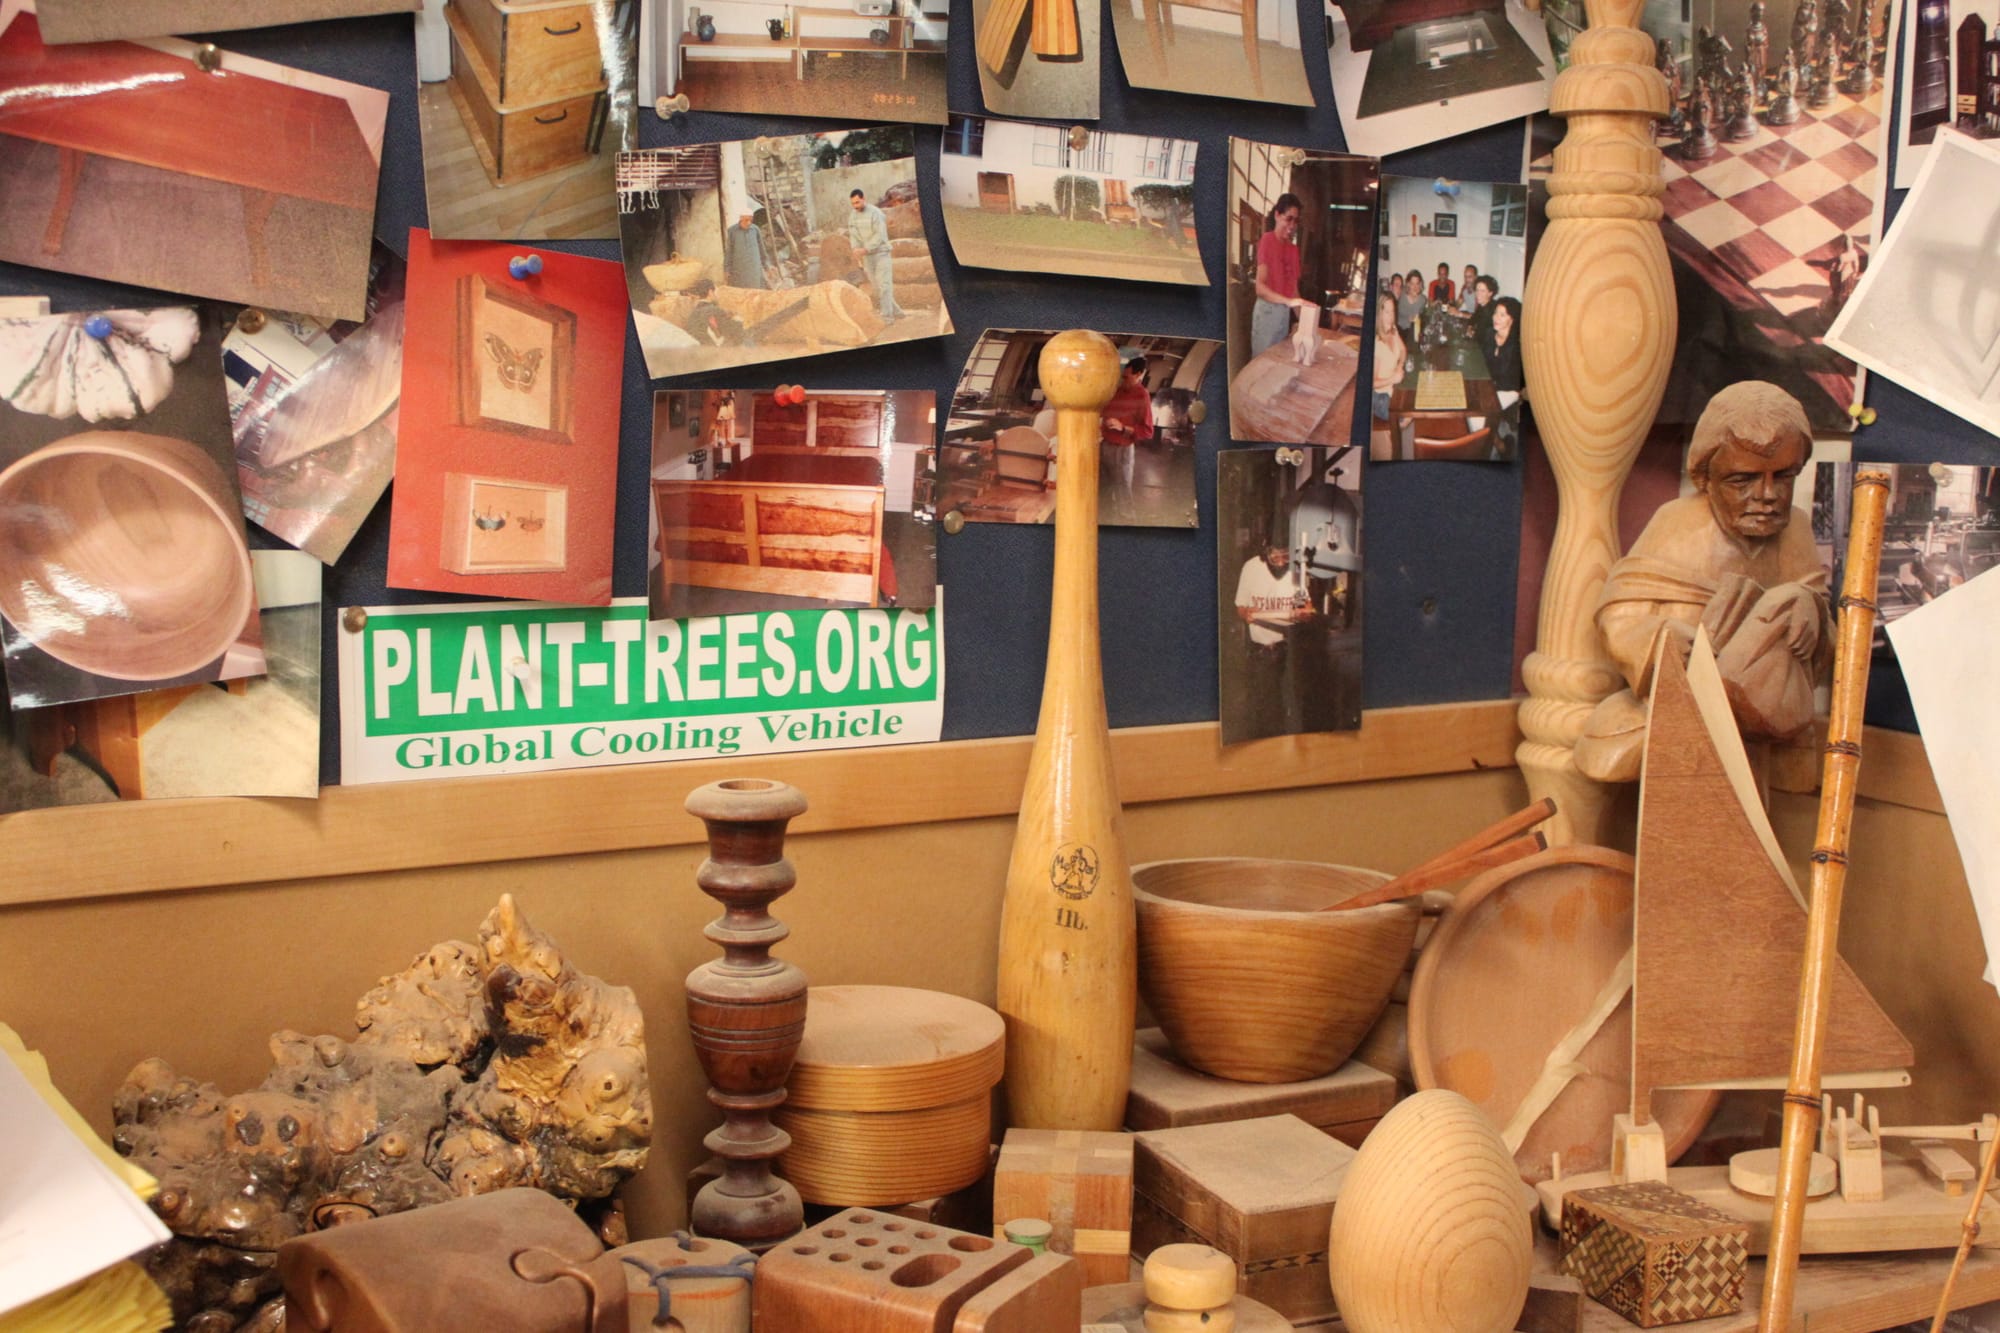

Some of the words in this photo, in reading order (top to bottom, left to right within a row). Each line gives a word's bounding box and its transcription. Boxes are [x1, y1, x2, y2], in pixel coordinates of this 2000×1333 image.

[372, 608, 932, 719] PLANT-TREES.ORG
[395, 729, 555, 770] Global
[570, 720, 742, 757] Cooling
[757, 708, 903, 744] Vehicle
